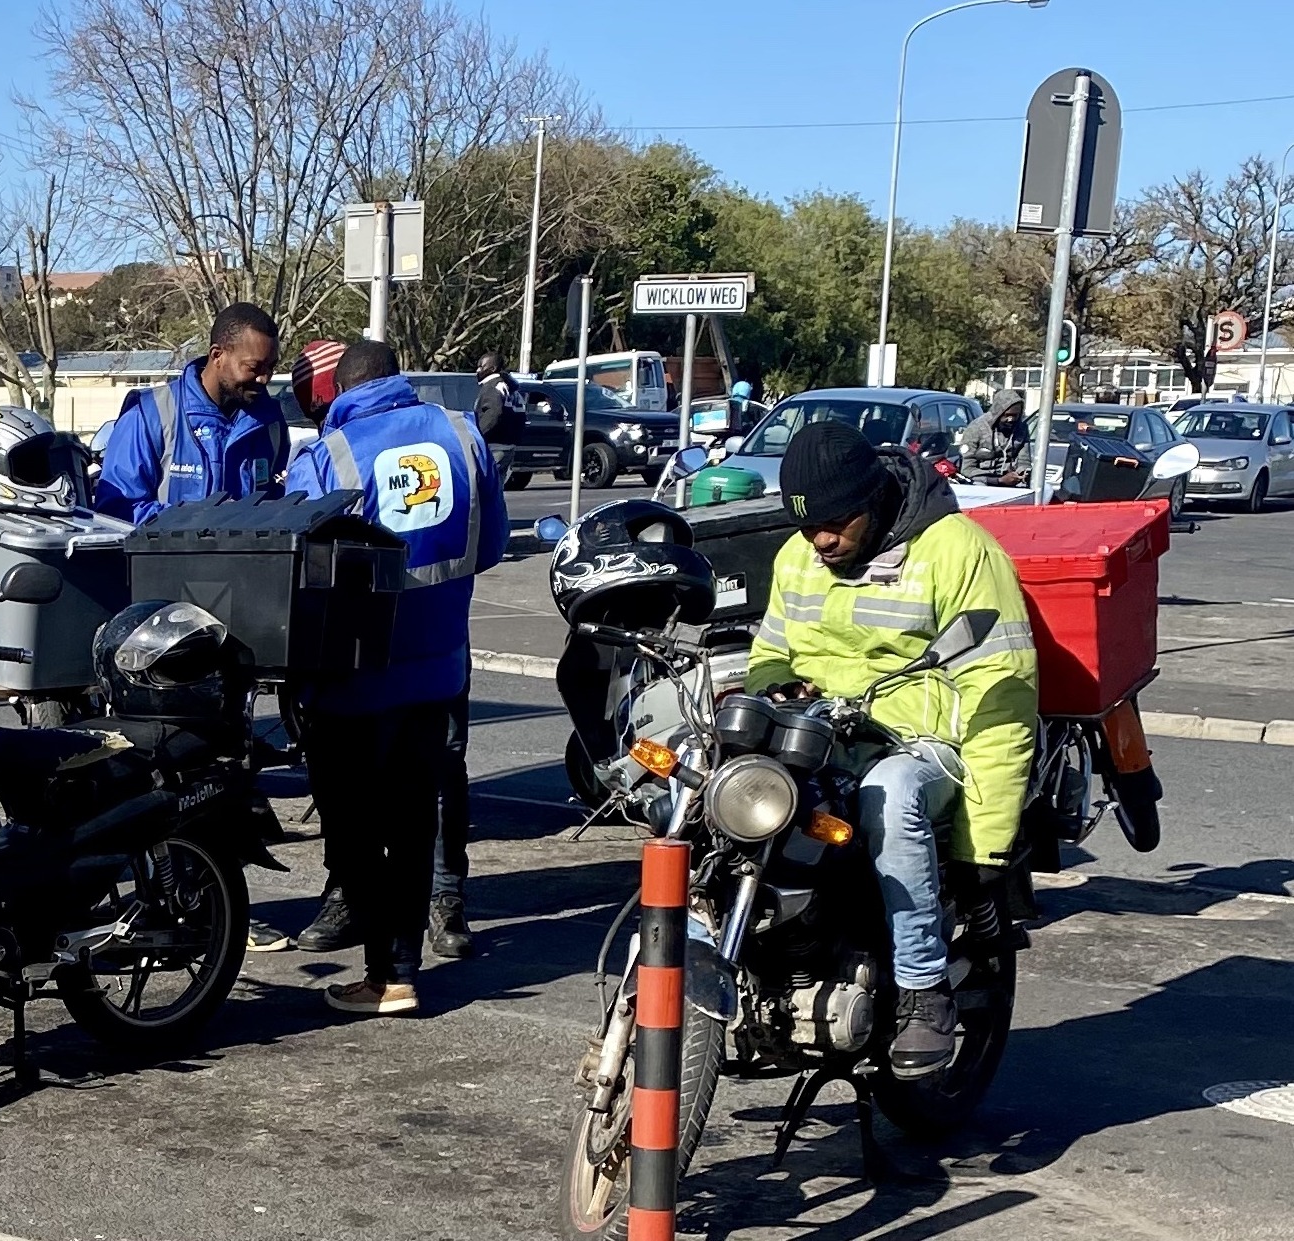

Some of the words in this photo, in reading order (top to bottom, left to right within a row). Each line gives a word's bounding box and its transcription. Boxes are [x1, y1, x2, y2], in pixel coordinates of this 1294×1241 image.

[647, 287, 707, 305] WICKLOW
[710, 287, 737, 305] WEG
[1218, 320, 1235, 342] S
[389, 474, 410, 491] MR
